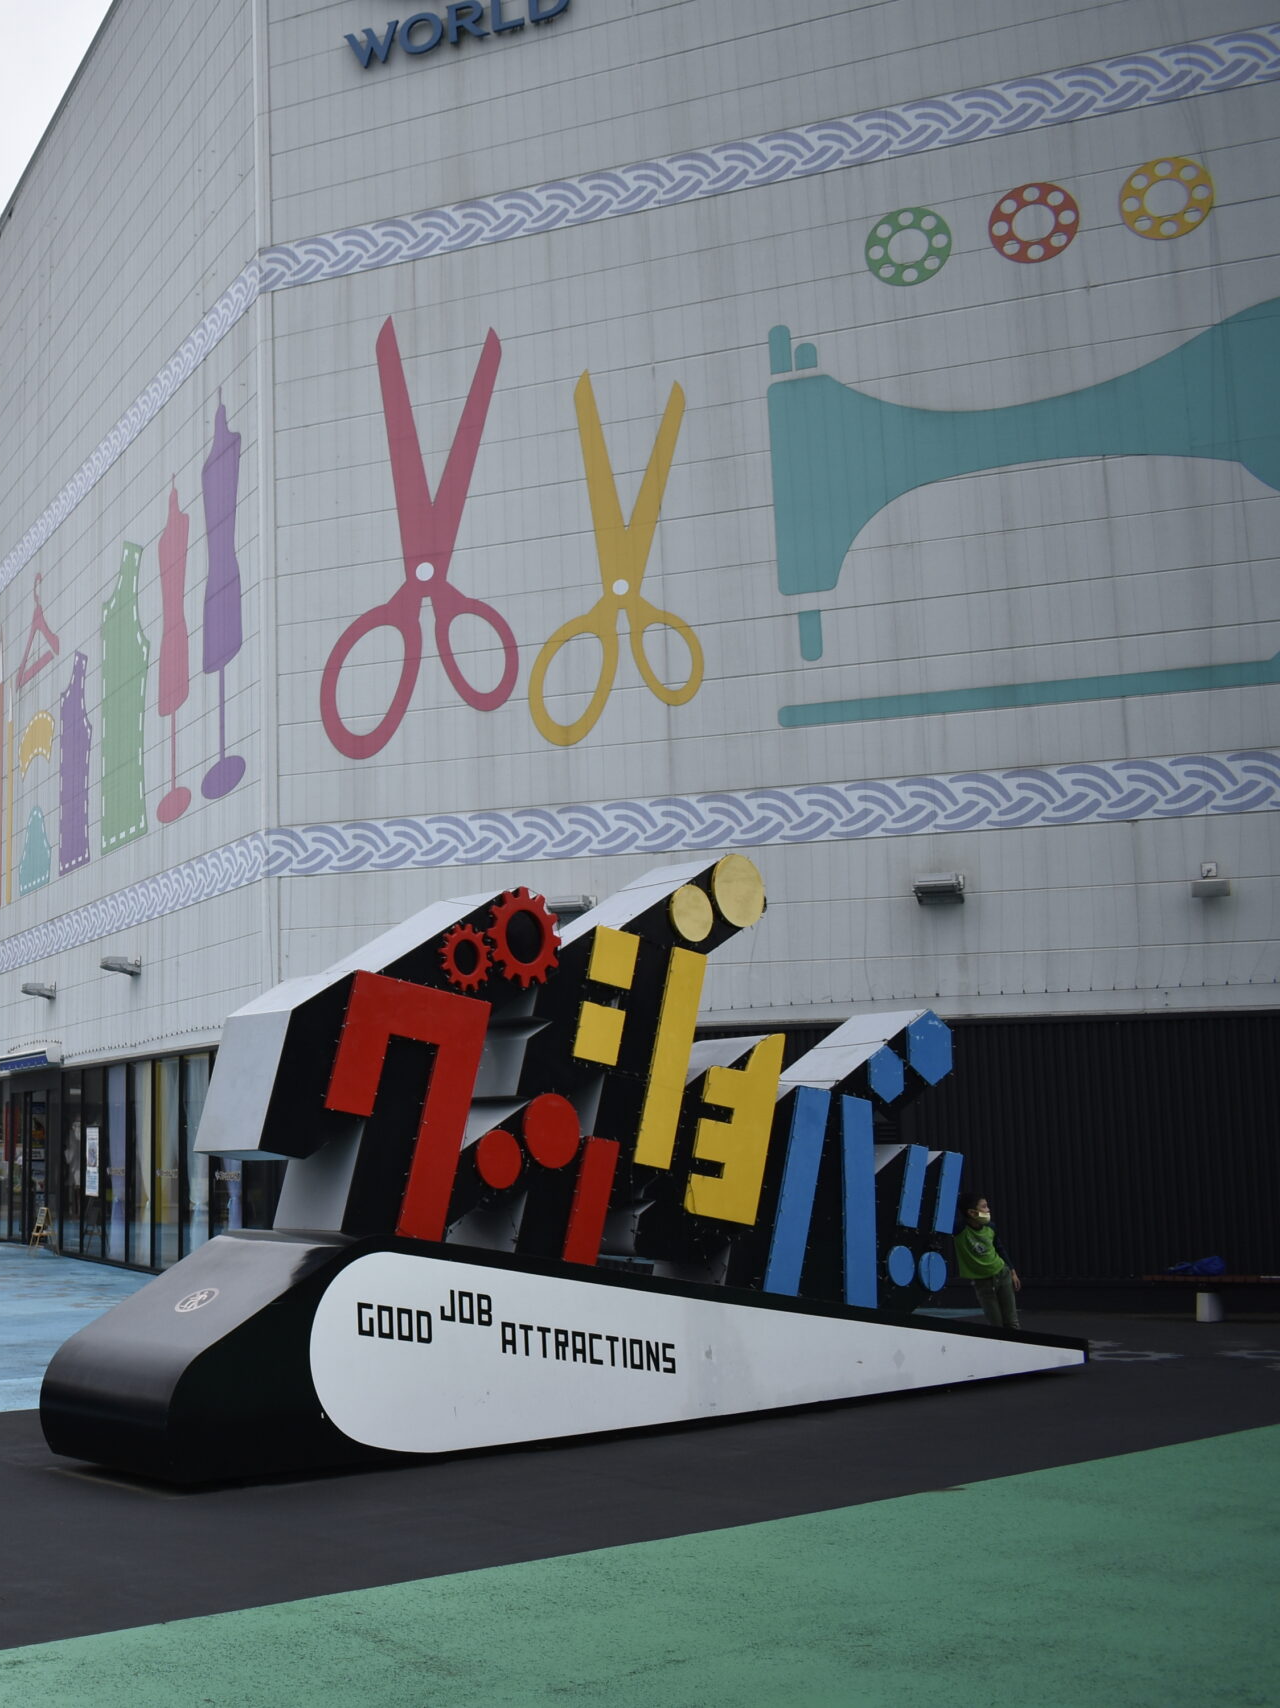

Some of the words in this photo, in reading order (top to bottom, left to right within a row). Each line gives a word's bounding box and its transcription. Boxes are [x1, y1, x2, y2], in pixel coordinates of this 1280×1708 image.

[357, 1302, 432, 1344] GOOD
[440, 1289, 492, 1326] JOB
[501, 1321, 676, 1374] ATTRACTIONS
